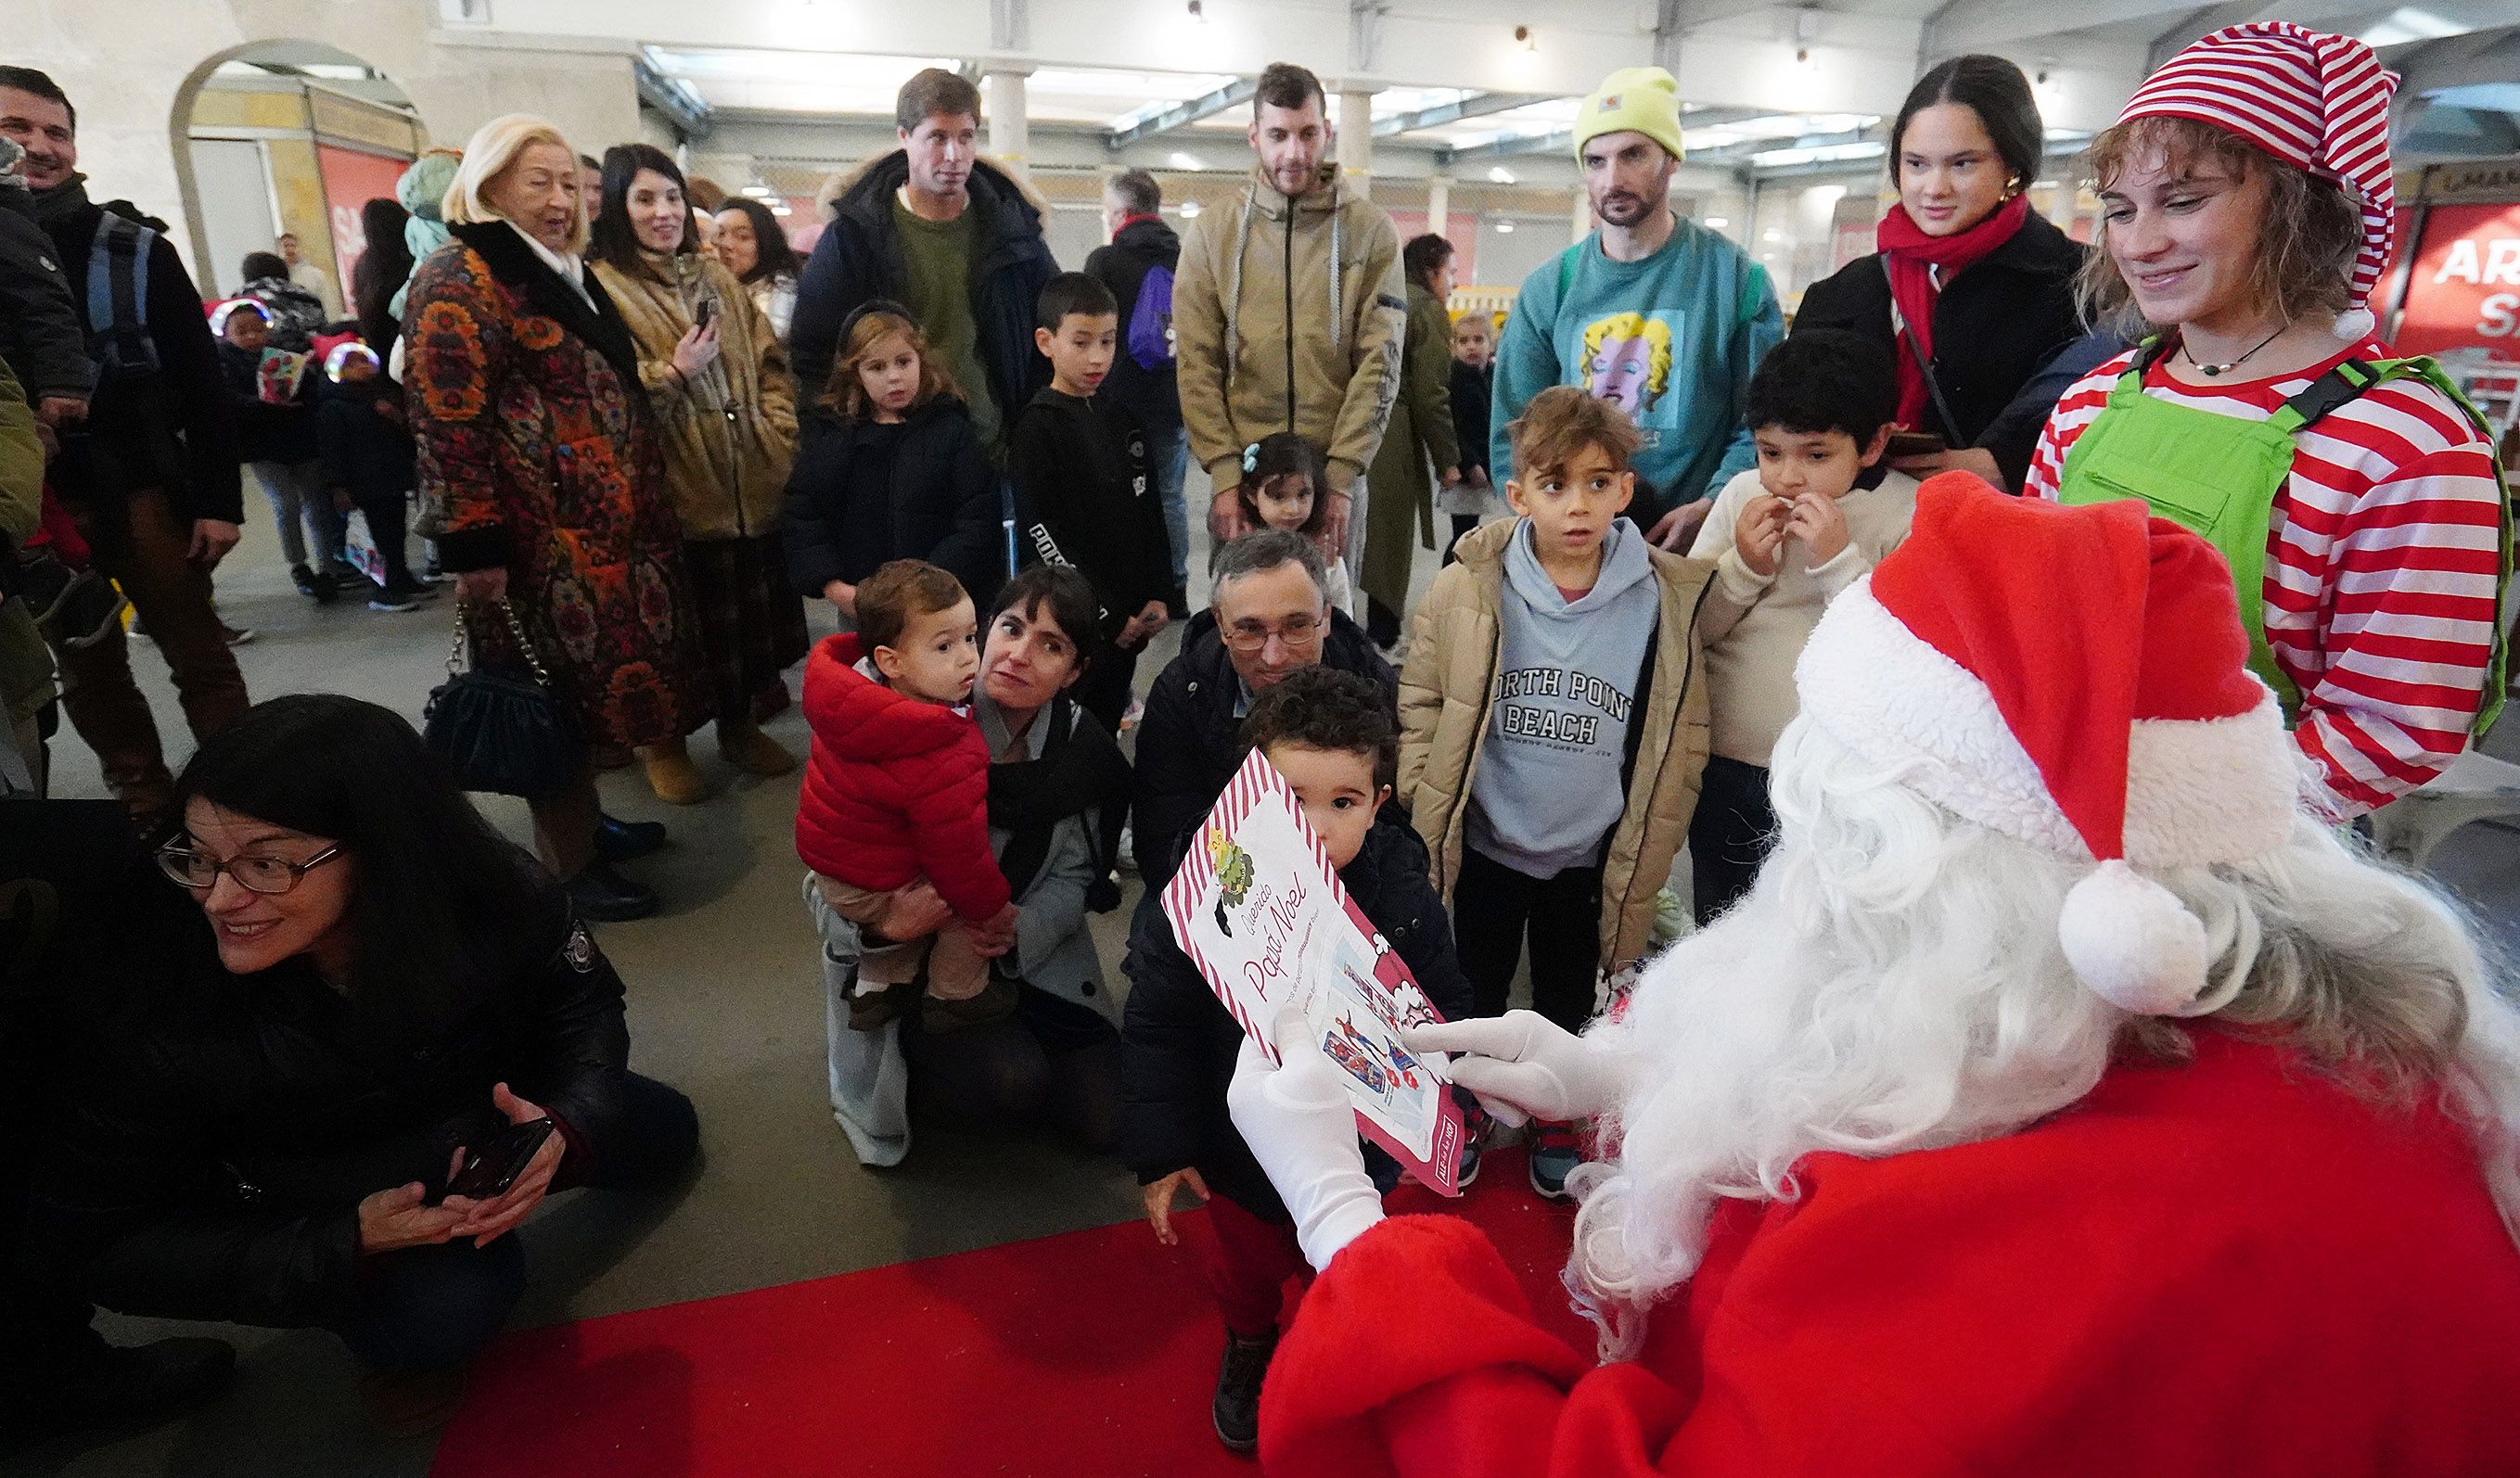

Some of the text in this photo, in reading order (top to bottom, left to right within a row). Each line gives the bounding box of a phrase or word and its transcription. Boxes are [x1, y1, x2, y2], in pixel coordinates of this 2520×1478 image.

[2475, 293, 2520, 338] S
[1568, 671, 1633, 722] POIN
[1504, 705, 1598, 745] BEACH
[1241, 883, 1273, 936] Querido
[1244, 872, 1307, 1002] Papá Noel
[1445, 1122, 1454, 1140] HOP
